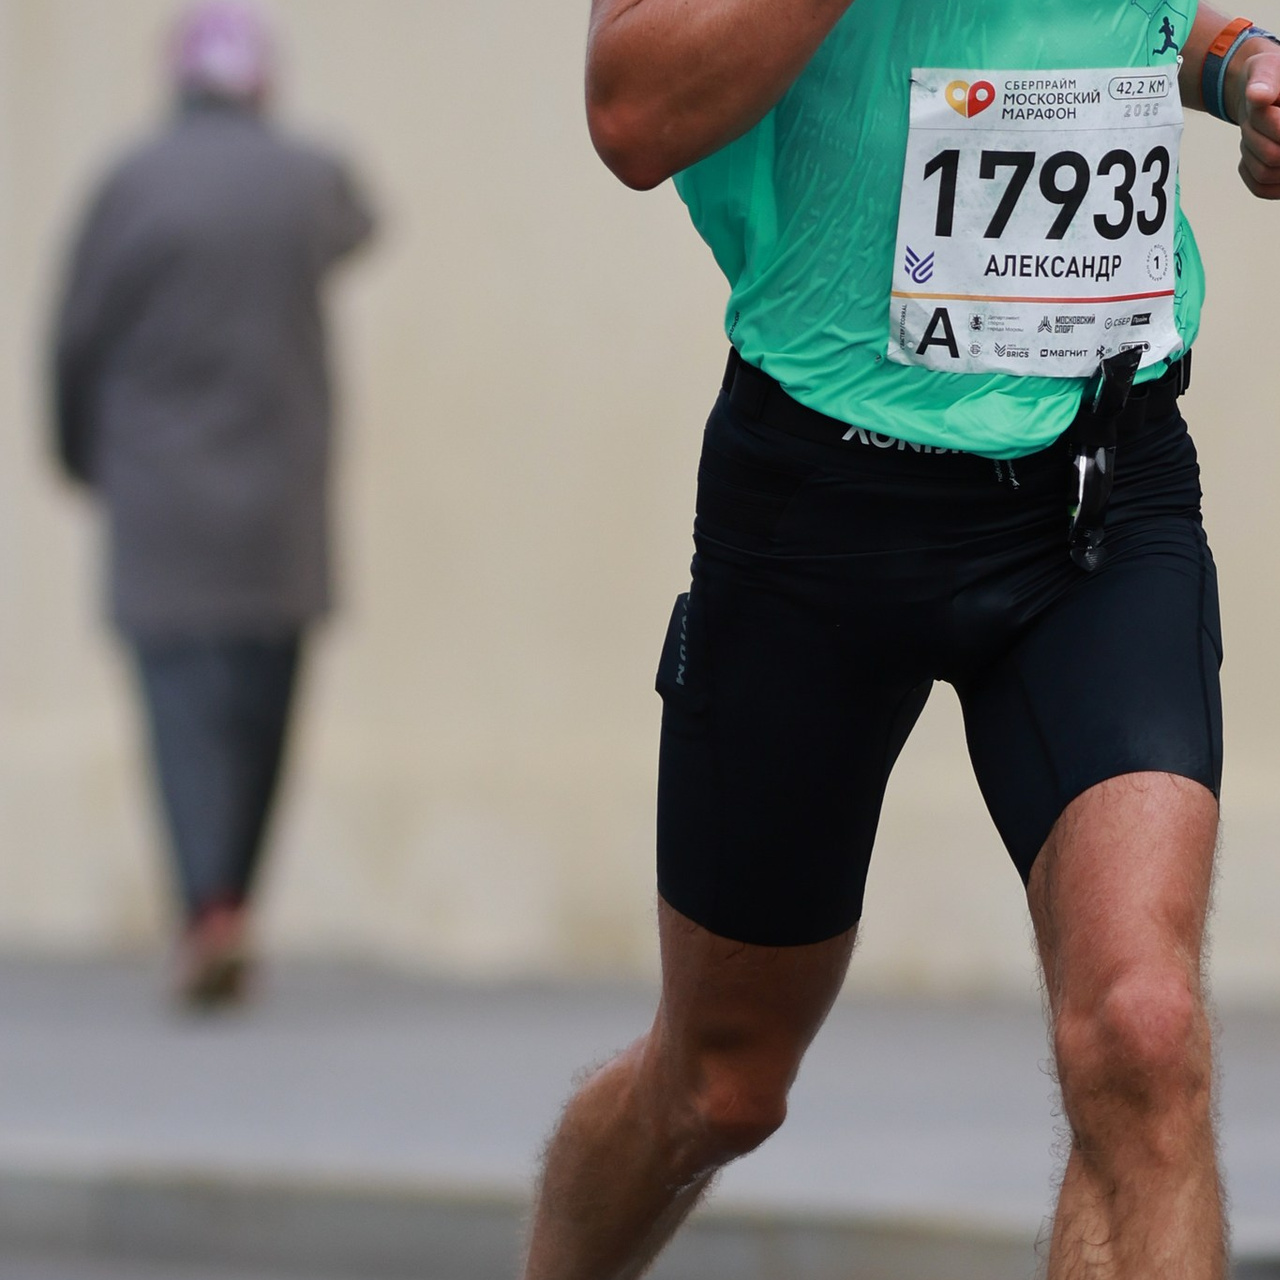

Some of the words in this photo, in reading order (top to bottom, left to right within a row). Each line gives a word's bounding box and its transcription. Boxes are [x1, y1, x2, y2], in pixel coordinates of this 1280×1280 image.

[1004, 78, 1077, 90] СБЕРПРАЙМ
[1116, 80, 1145, 96] 42,2
[1003, 89, 1100, 106] МОСКОВСКИЙ
[1001, 107, 1077, 120] МАРАФОН
[924, 145, 1170, 240] 17933
[984, 253, 1122, 282] АЛЕКСАНДР
[1153, 255, 1159, 270] 1
[1055, 314, 1096, 324] МОСКОВСКИЙ
[1113, 317, 1131, 327] СБЕР
[1054, 324, 1074, 333] СПОРТ
[1006, 350, 1029, 358] BRICS
[1049, 349, 1088, 357] магнит
